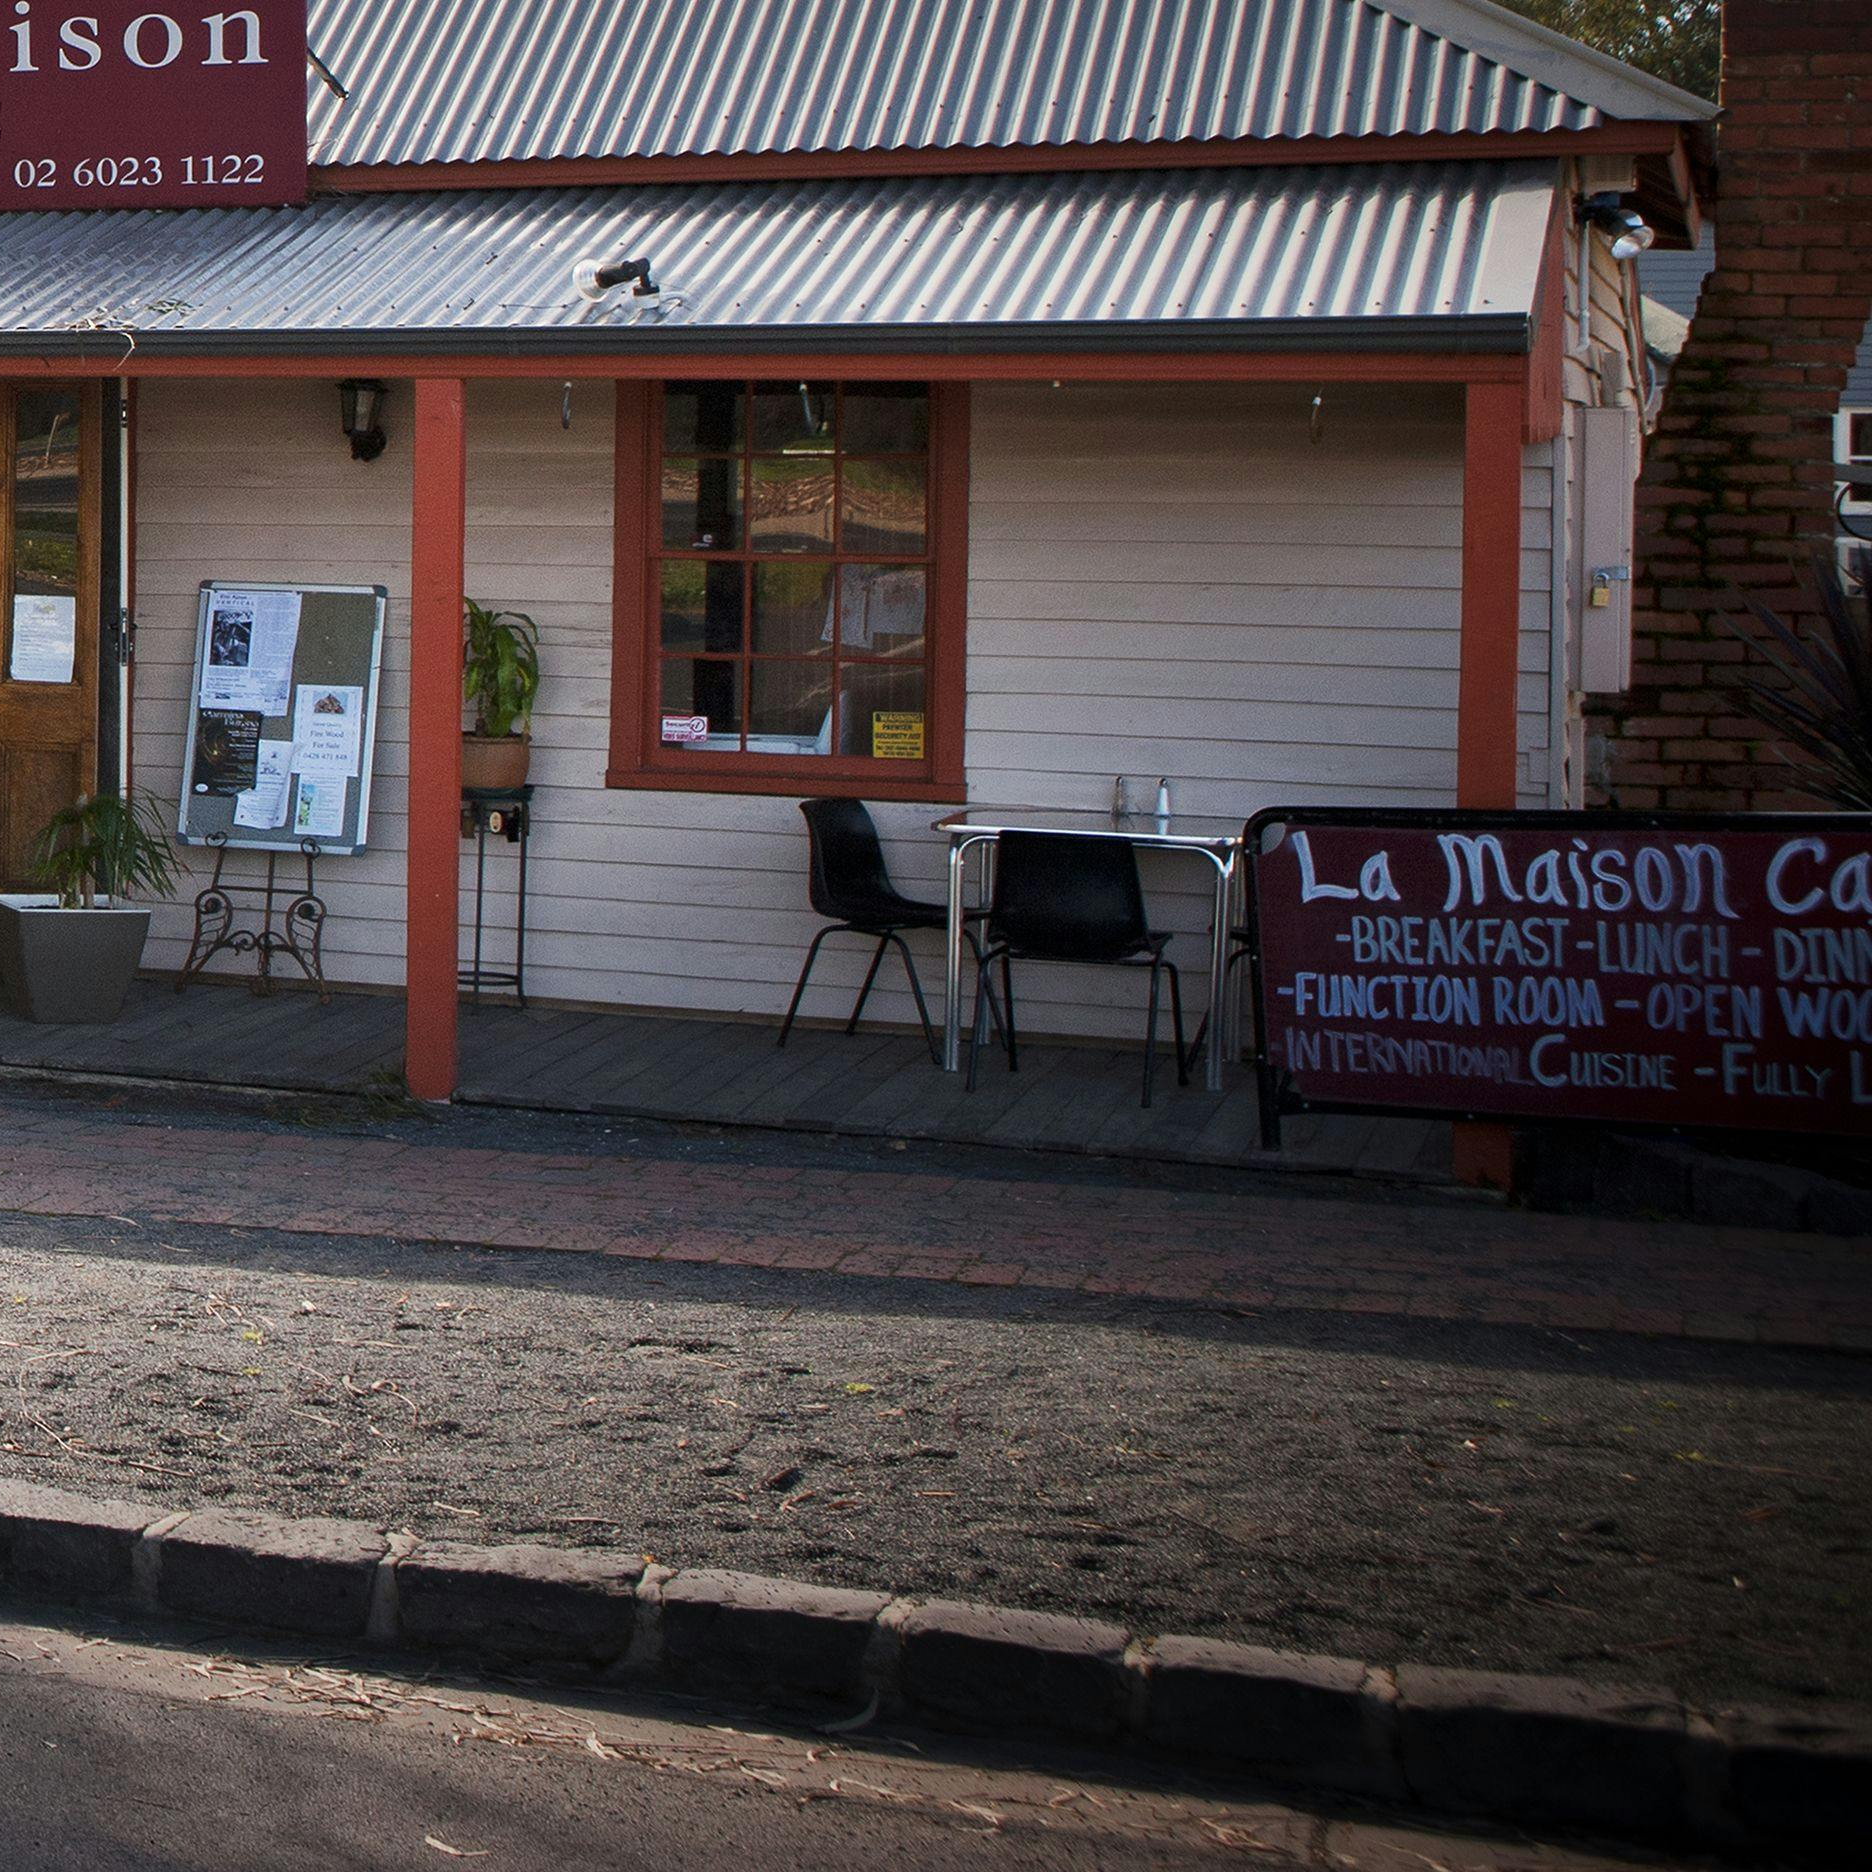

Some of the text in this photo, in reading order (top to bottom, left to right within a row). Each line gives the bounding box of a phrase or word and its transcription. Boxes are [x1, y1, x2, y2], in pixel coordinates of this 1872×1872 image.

[13, 157, 58, 189] 02
[72, 155, 164, 188] 6023
[180, 152, 266, 186] 1122
[1291, 829, 1401, 904] La
[1436, 832, 1741, 920] Maison
[1492, 975, 1606, 1028] ROOM
[1646, 981, 1763, 1040] OPEN
